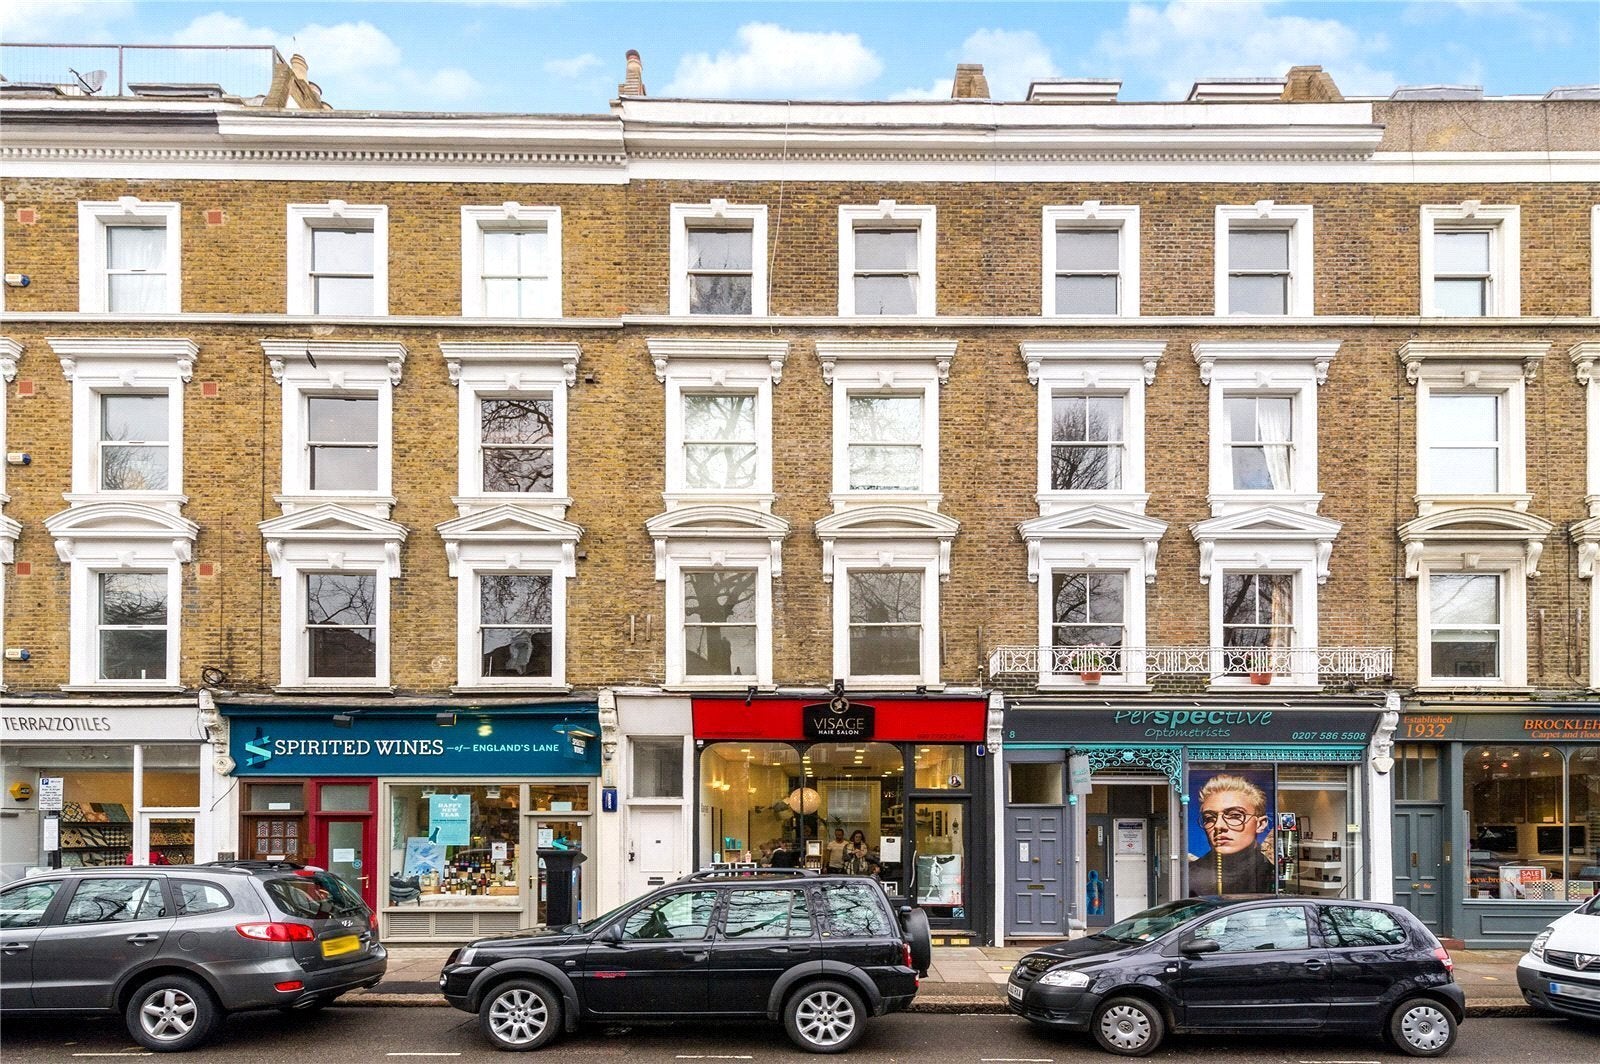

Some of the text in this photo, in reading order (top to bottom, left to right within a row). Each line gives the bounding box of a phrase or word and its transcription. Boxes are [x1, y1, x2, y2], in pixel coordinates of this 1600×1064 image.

[2, 717, 111, 731] TERRAZZOTILES
[813, 718, 864, 729] VISAGE
[1114, 710, 1272, 728] Perspective
[1404, 715, 1453, 723] Established
[1144, 727, 1231, 740] Optometrists
[1292, 732, 1366, 740] 0207 586 5508
[1407, 723, 1446, 737] 1932
[1531, 731, 1560, 739] Carpet
[274, 739, 371, 755] SPIRITED
[374, 739, 444, 755] WINES
[473, 744, 530, 752] ENGLAND'S
[533, 744, 559, 752] LANE
